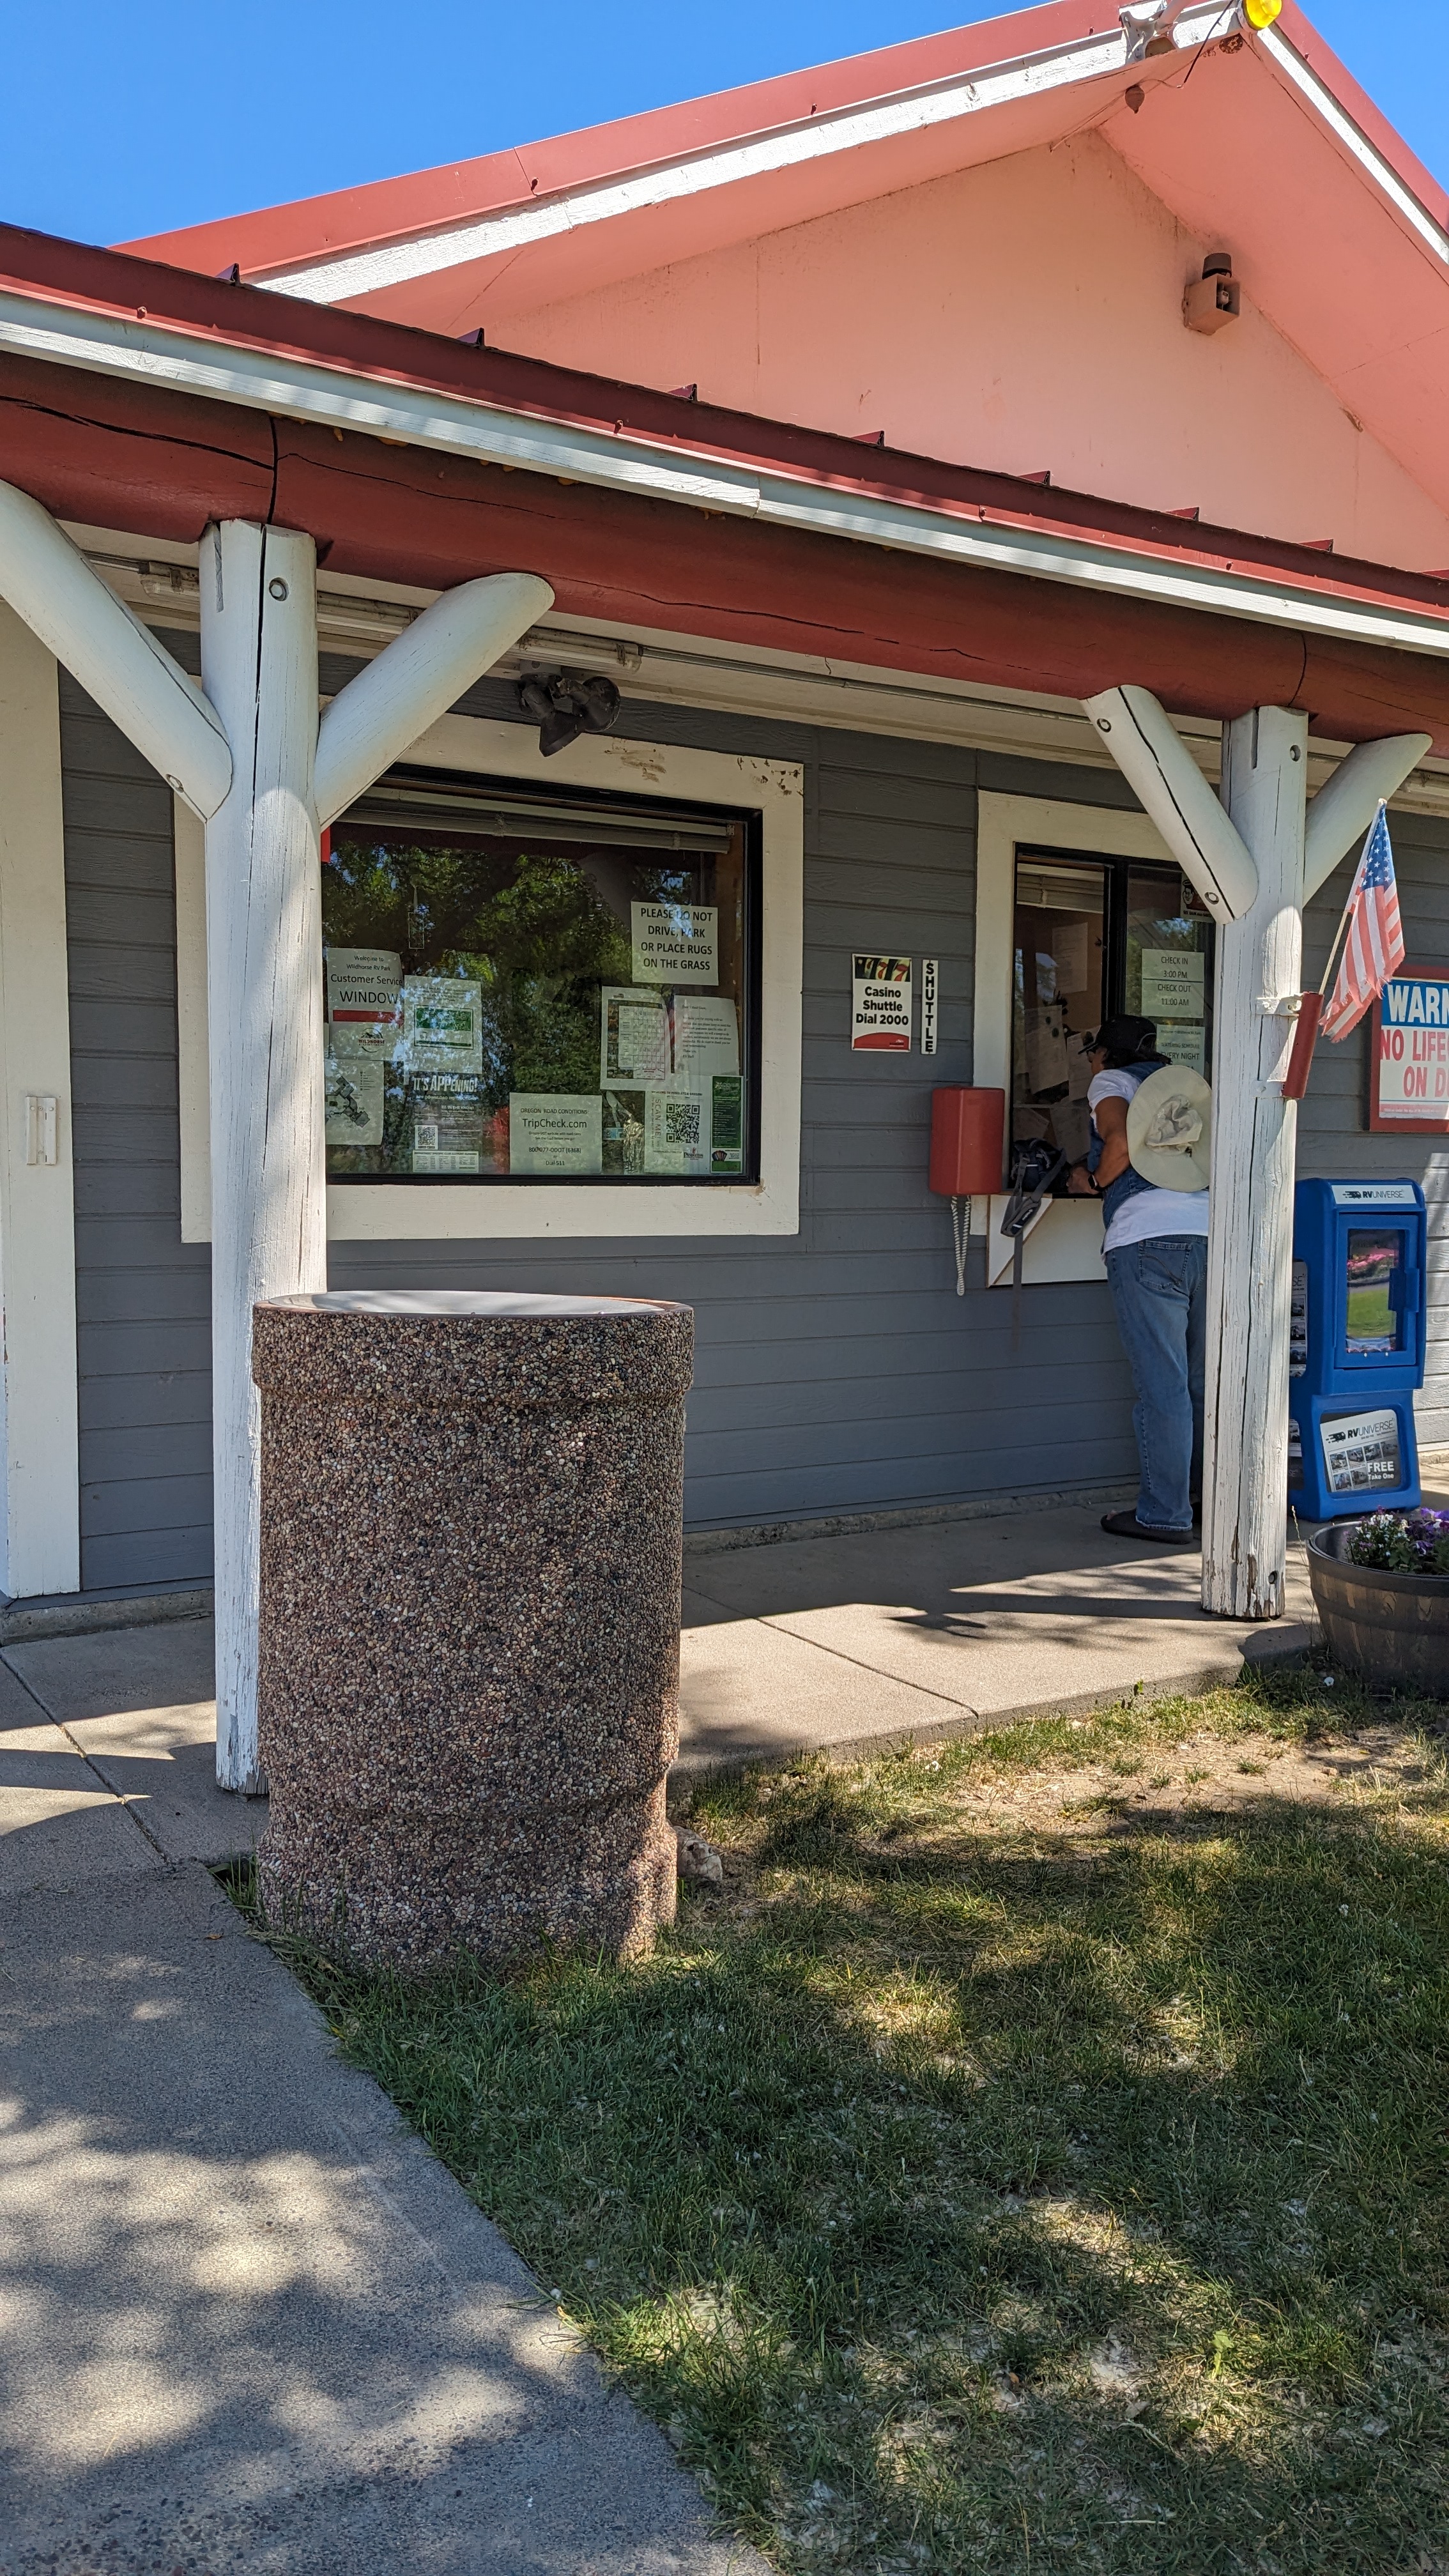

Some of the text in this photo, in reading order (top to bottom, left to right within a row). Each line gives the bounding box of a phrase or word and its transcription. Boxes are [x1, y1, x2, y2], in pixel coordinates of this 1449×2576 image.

[641, 908, 712, 921] PLEASE DO NOT
[648, 926, 705, 938] DRIVE, PARK
[641, 942, 712, 954] OR PLACE RUGS
[643, 958, 710, 970] ON THE GRASS
[1161, 956, 1181, 965] CHECK
[330, 974, 402, 986] Customer Service
[1163, 970, 1176, 978] 3:00
[864, 986, 901, 998] Casino
[1157, 983, 1177, 992] CHECK
[339, 990, 399, 1004] WINDOW
[862, 1000, 903, 1011] Shuttle
[925, 963, 935, 1052] SHUTTLE
[855, 1013, 909, 1025] Dial 2000
[1380, 1029, 1404, 1061] NO
[413, 1075, 478, 1092] IT'S APPENING!
[1403, 1065, 1428, 1098] ON
[522, 1118, 587, 1130] TripCheck.com
[1367, 1461, 1395, 1473] FREE
